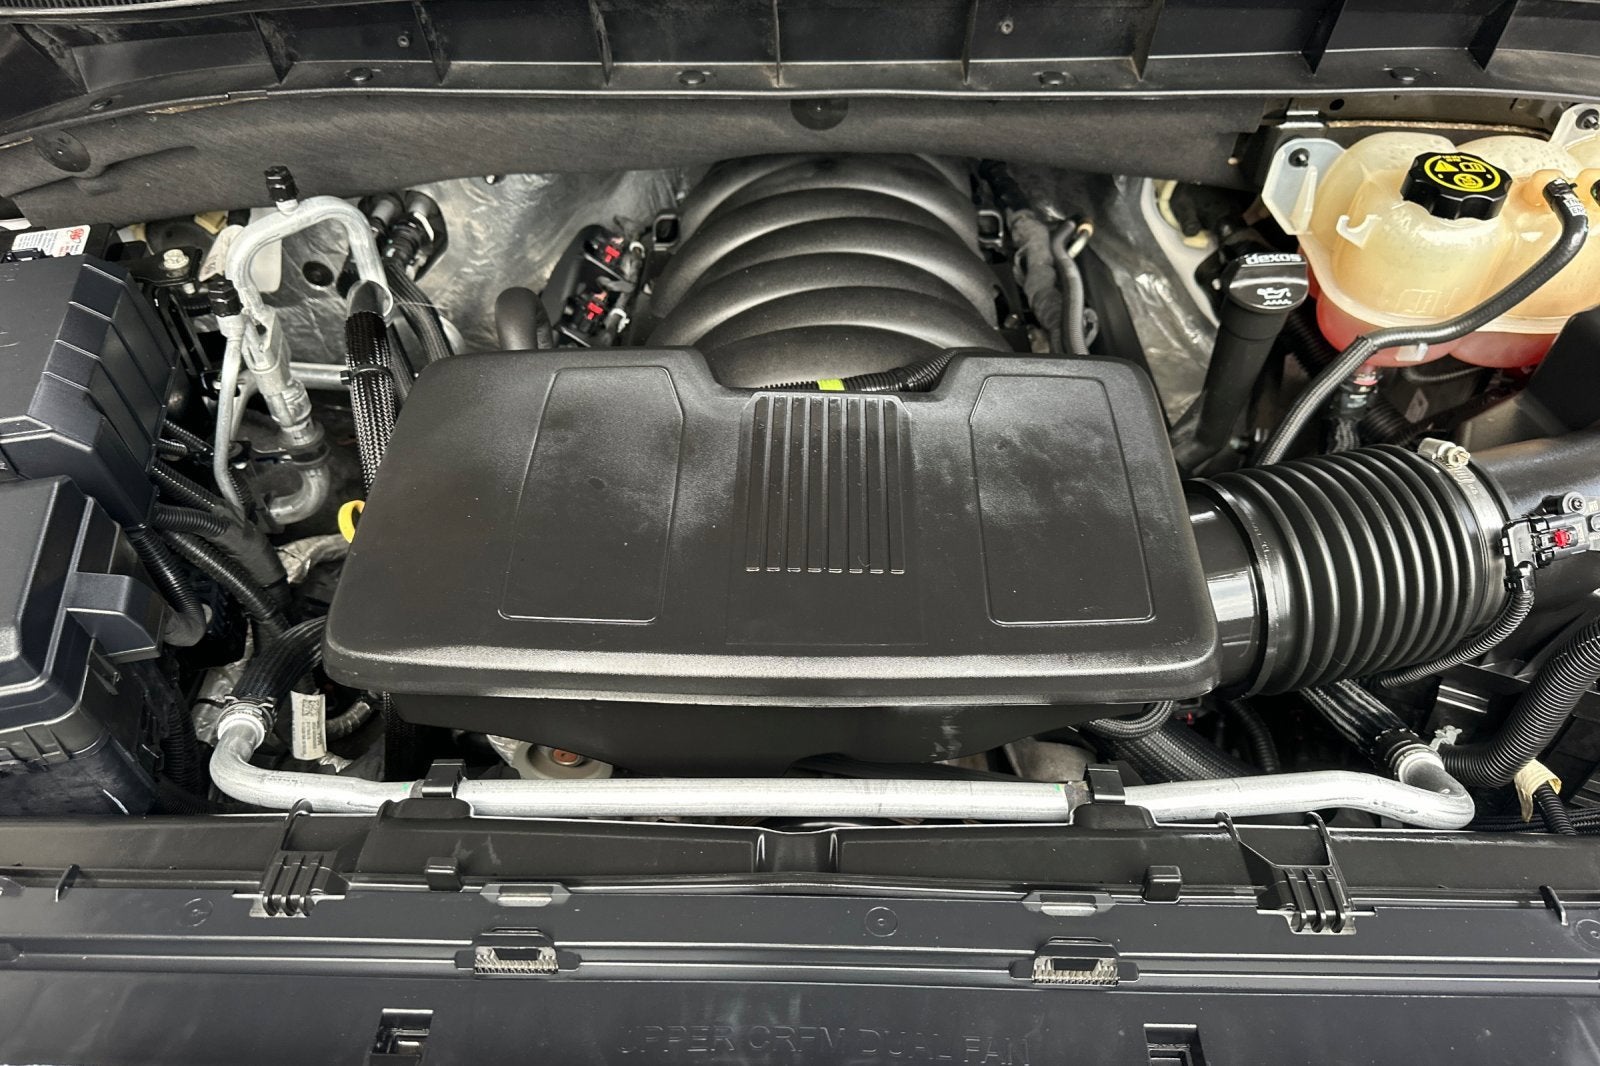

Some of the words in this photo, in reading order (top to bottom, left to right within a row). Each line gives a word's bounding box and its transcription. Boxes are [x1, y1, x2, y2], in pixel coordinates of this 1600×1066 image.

[1245, 252, 1302, 265] dexos
[617, 1025, 736, 1054] UPPER
[858, 1027, 953, 1061] DUAL
[961, 1034, 1030, 1066] FAN
